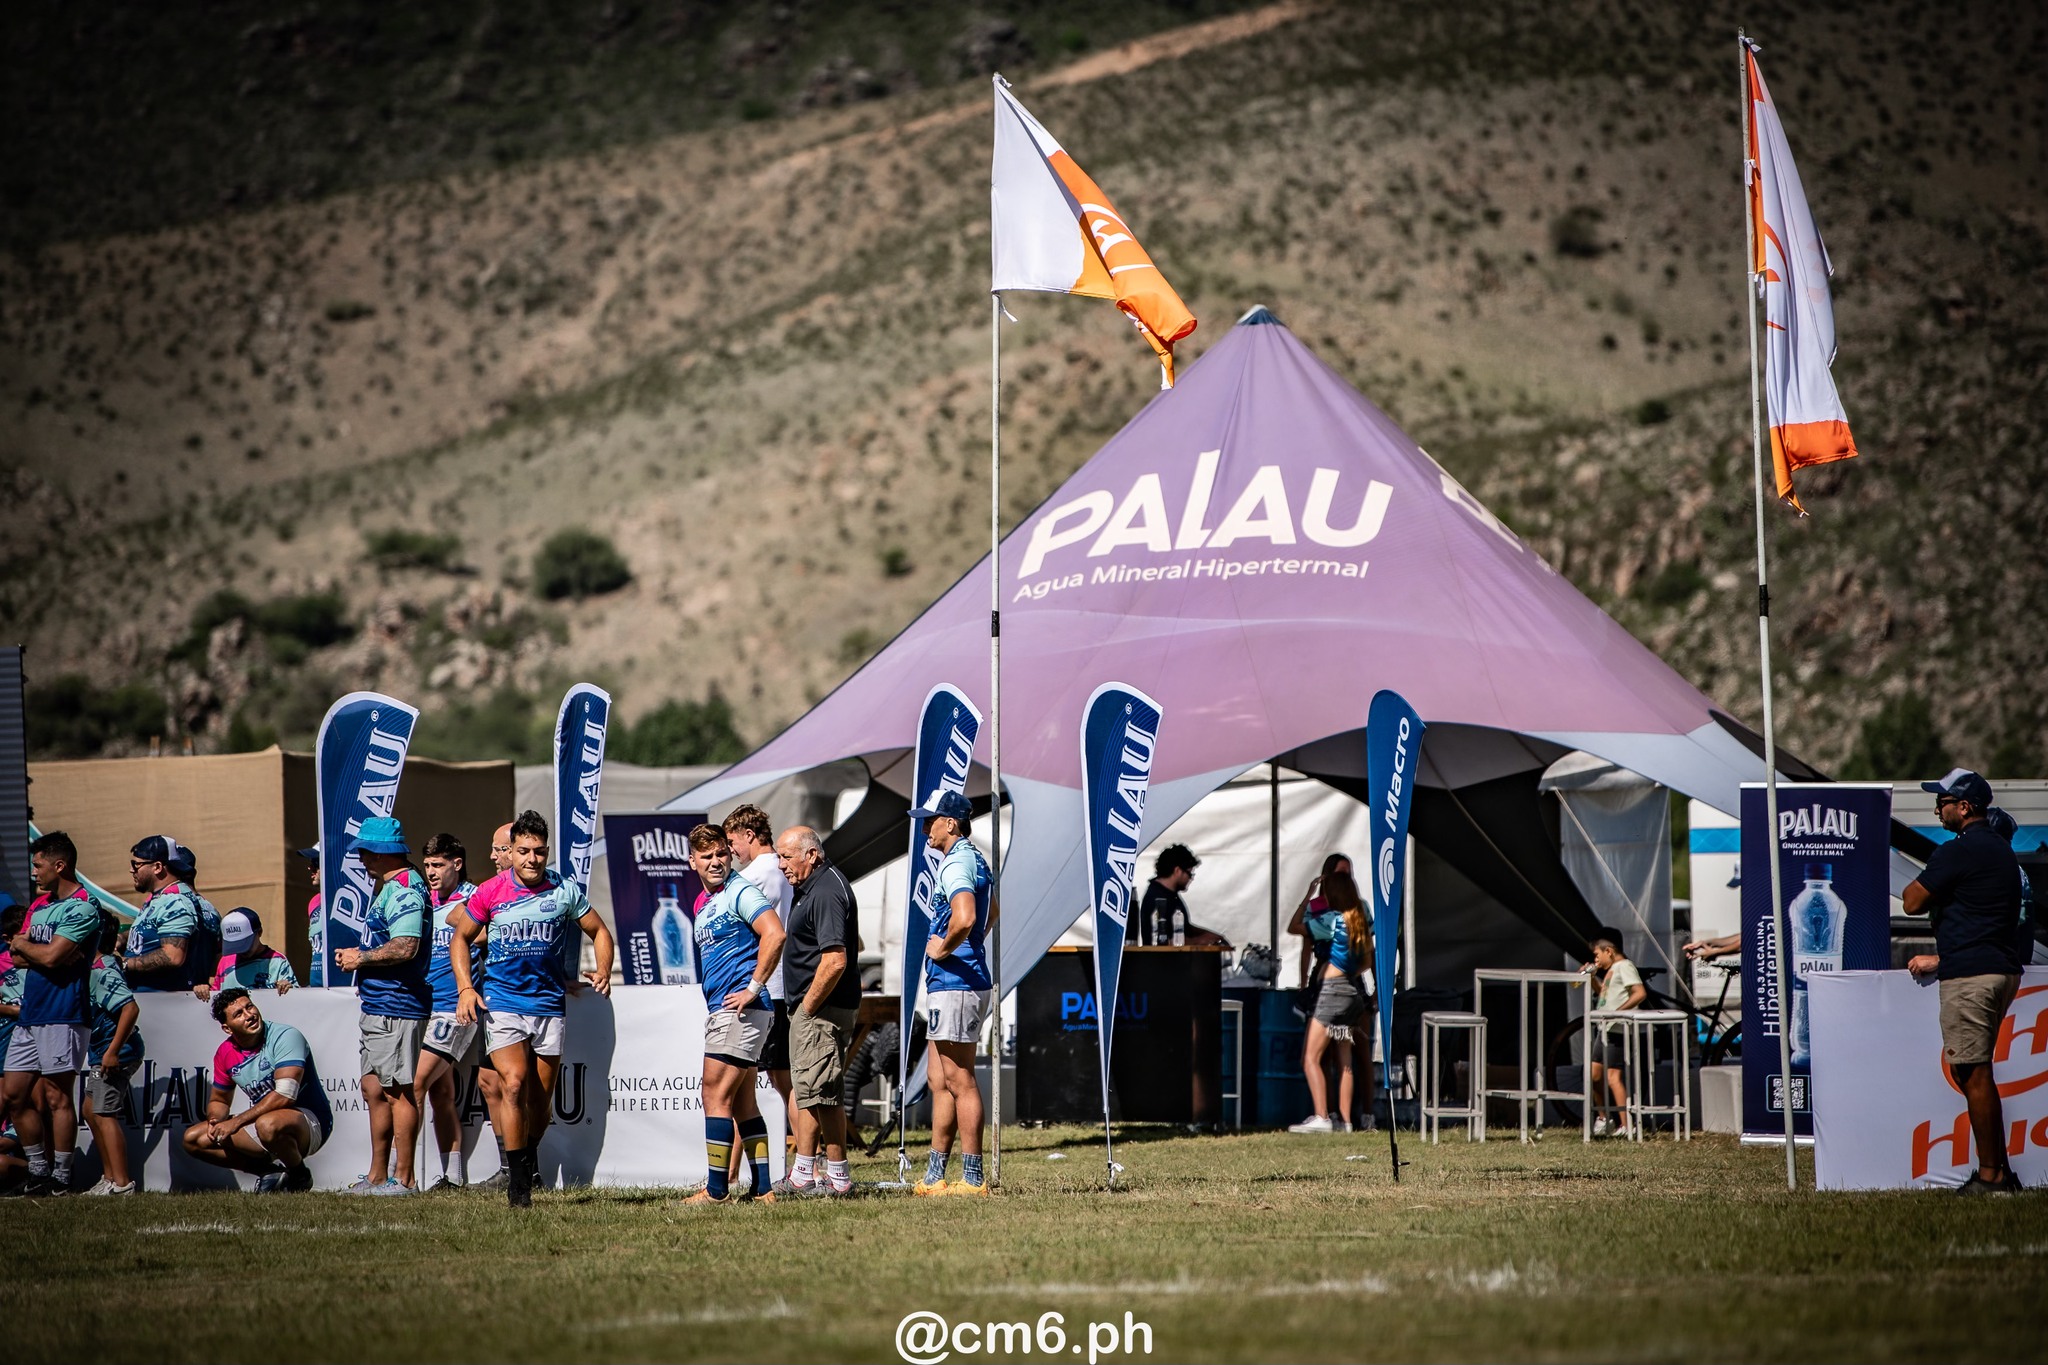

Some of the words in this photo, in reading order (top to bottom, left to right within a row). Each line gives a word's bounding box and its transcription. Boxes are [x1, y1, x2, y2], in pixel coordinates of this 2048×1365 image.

[1018, 449, 1394, 579] PALAU
[1012, 571, 1084, 603] Agua
[1090, 559, 1191, 585] Mineral
[1193, 557, 1370, 581] Hipertermal
[1384, 716, 1410, 833] Macro
[1100, 720, 1155, 928] PALAU
[1778, 803, 1858, 841] PALAU
[631, 827, 690, 863] PALAU
[1792, 849, 1845, 857] HIPERTERMAL
[1805, 842, 1824, 850] AGUA
[1824, 842, 1855, 850] MINERAL
[499, 918, 554, 946] PALAU
[1757, 921, 1766, 973] ALCALINA
[608, 1075, 657, 1092] ÚNICA
